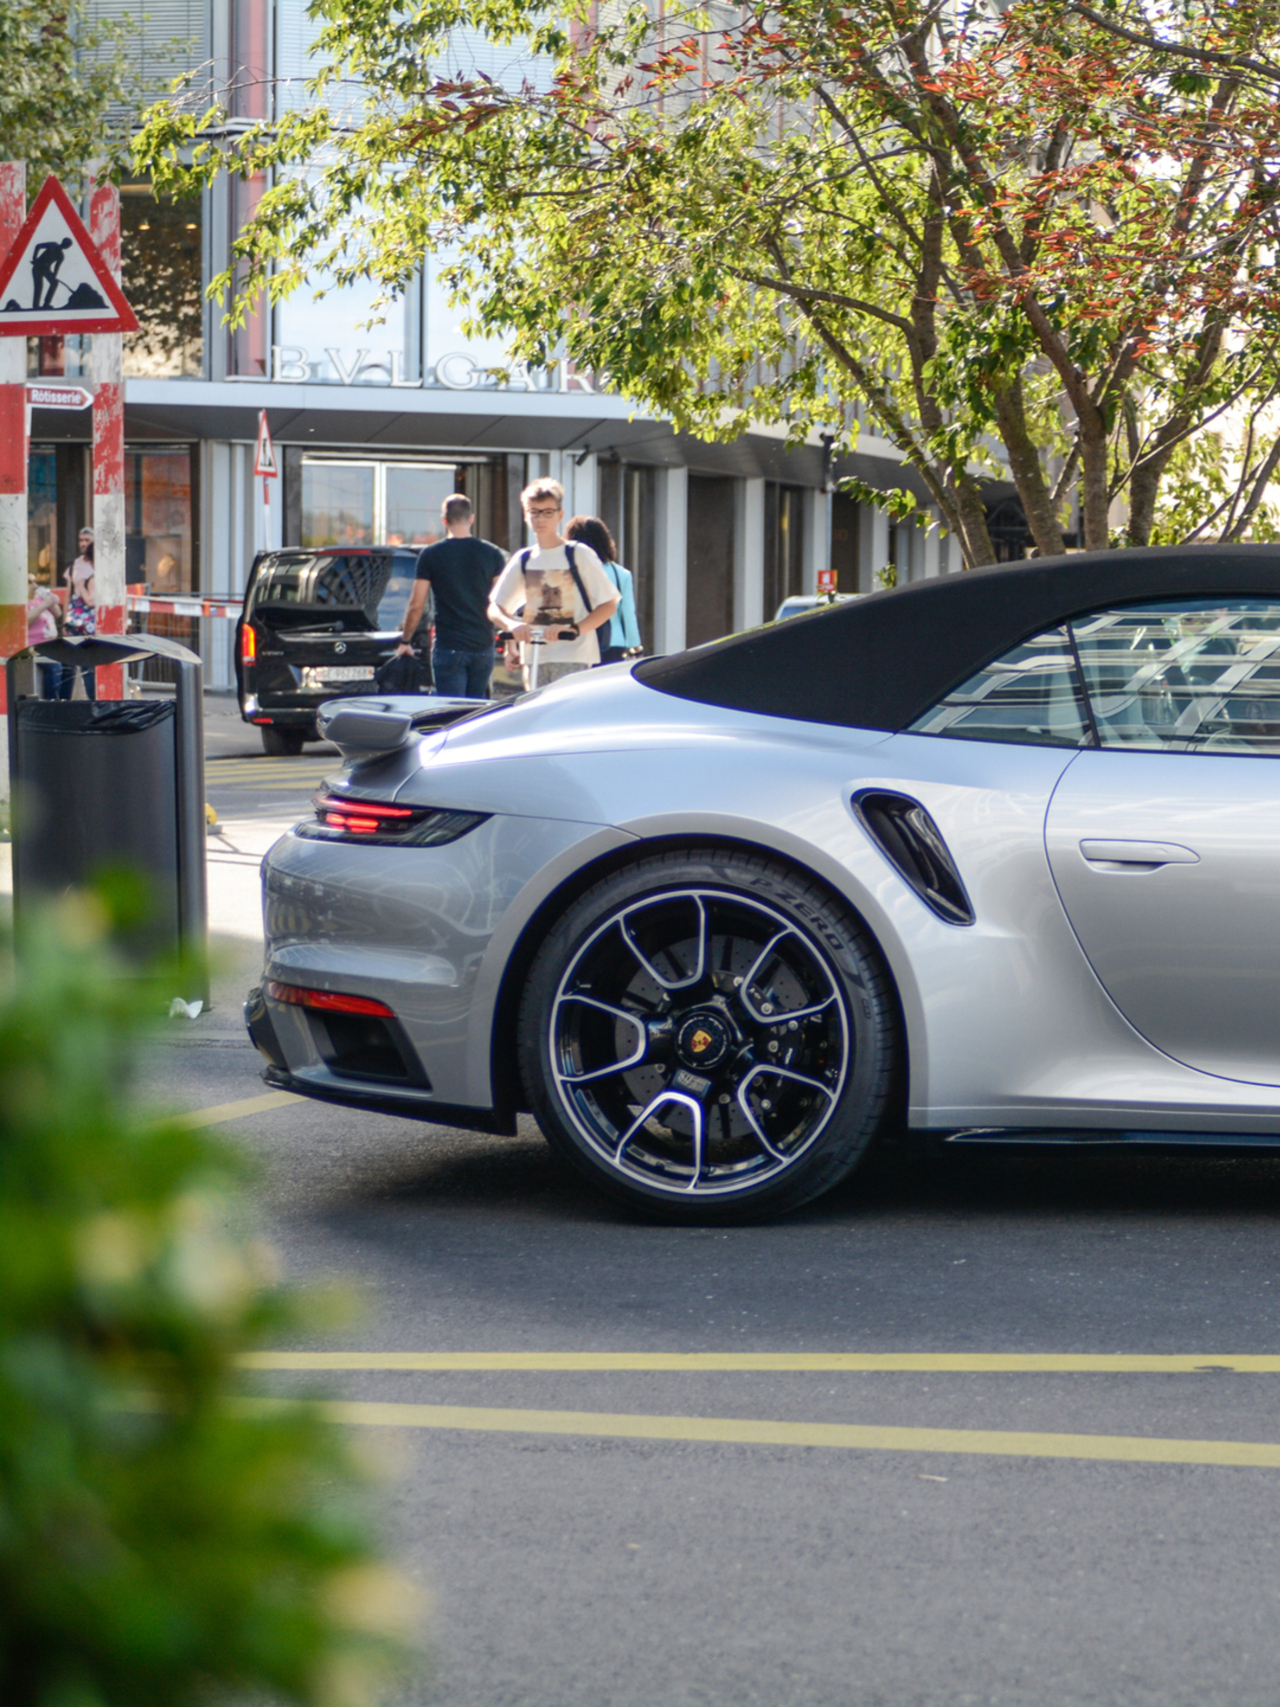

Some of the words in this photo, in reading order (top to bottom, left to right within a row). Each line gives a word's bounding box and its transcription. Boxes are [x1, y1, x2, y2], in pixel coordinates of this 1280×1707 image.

[271, 346, 597, 395] BVLGAR
[750, 878, 773, 888] P
[774, 889, 845, 950] ZERO
